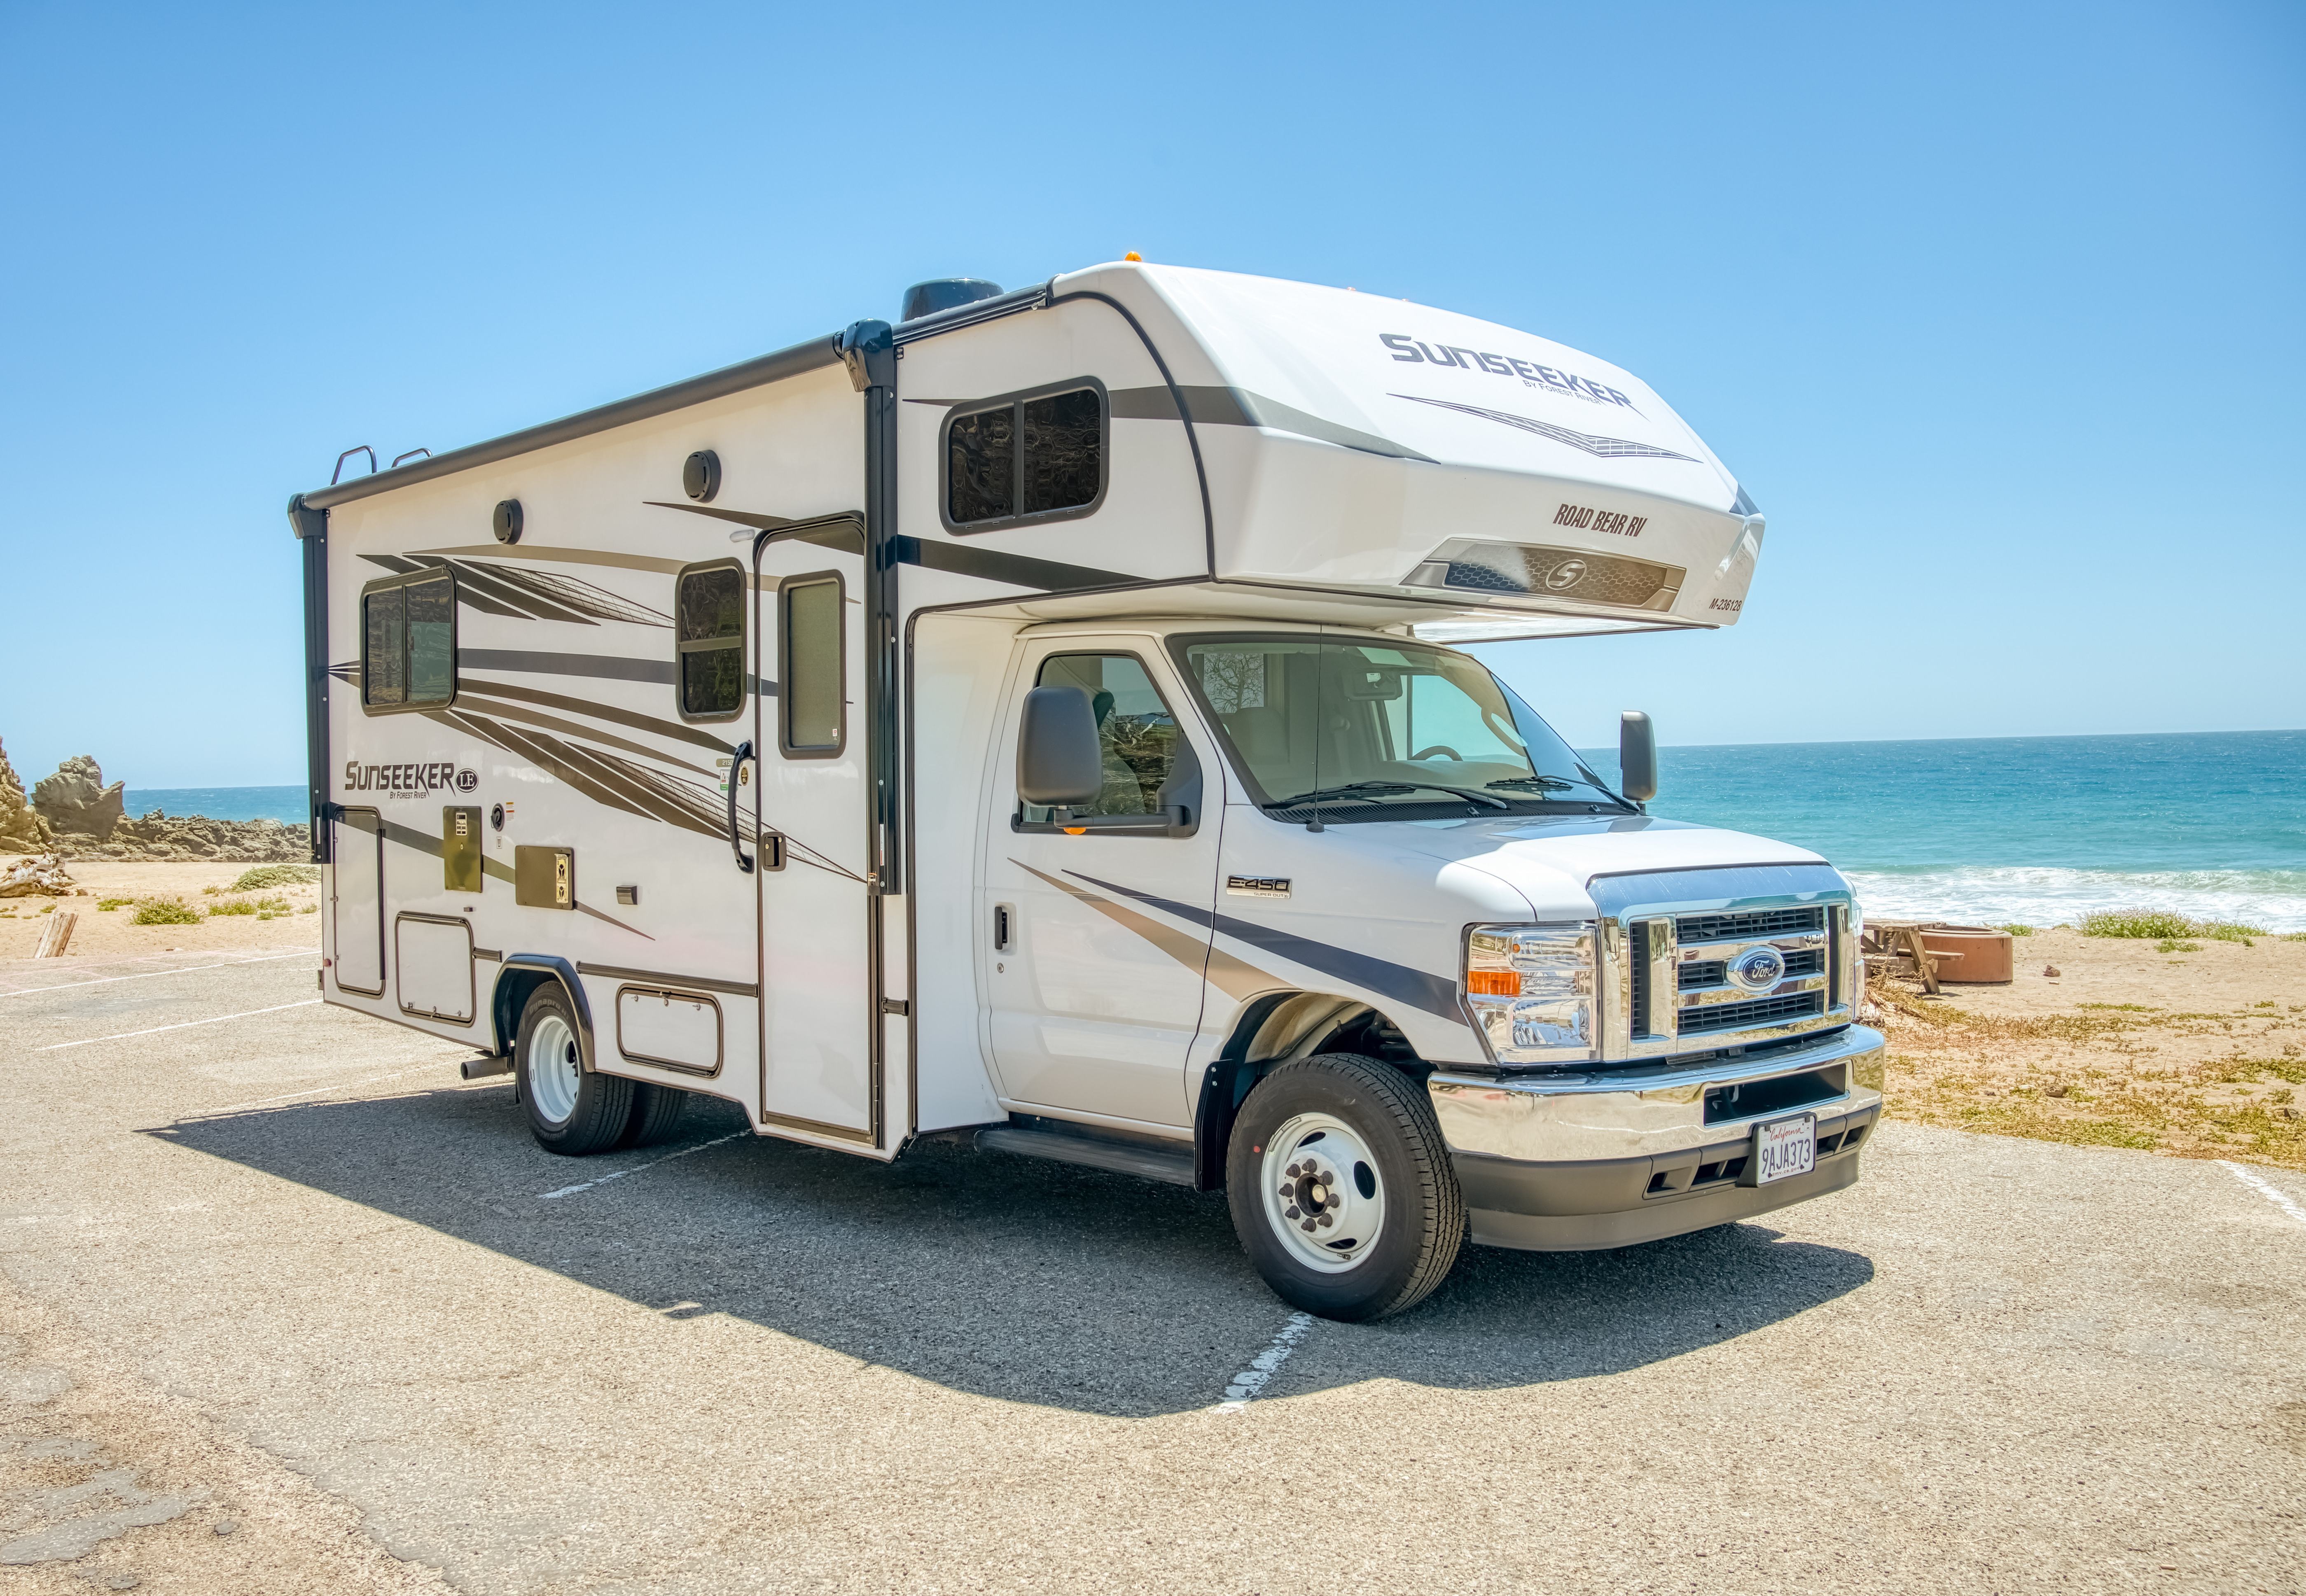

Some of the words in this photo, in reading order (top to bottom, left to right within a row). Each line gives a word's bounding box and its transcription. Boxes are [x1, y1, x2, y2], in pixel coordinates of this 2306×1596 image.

[1379, 334, 1651, 422] SUNSEEKER
[1523, 380, 1536, 388] BY
[1538, 383, 1574, 397] FOREST
[1575, 392, 1601, 405] RIVER
[1553, 504, 1594, 528] ROAD
[1591, 511, 1628, 534] BEAR
[1624, 516, 1648, 537] RV
[1709, 598, 1742, 611] M-236128
[345, 761, 456, 797] SUNSEEKER
[459, 773, 475, 787] LE
[1752, 960, 1775, 978] Ford
[1770, 1126, 1804, 1142] California
[1762, 1139, 1810, 1174] 9AJA373
[1772, 1166, 1800, 1176] dmv.ca.gov
